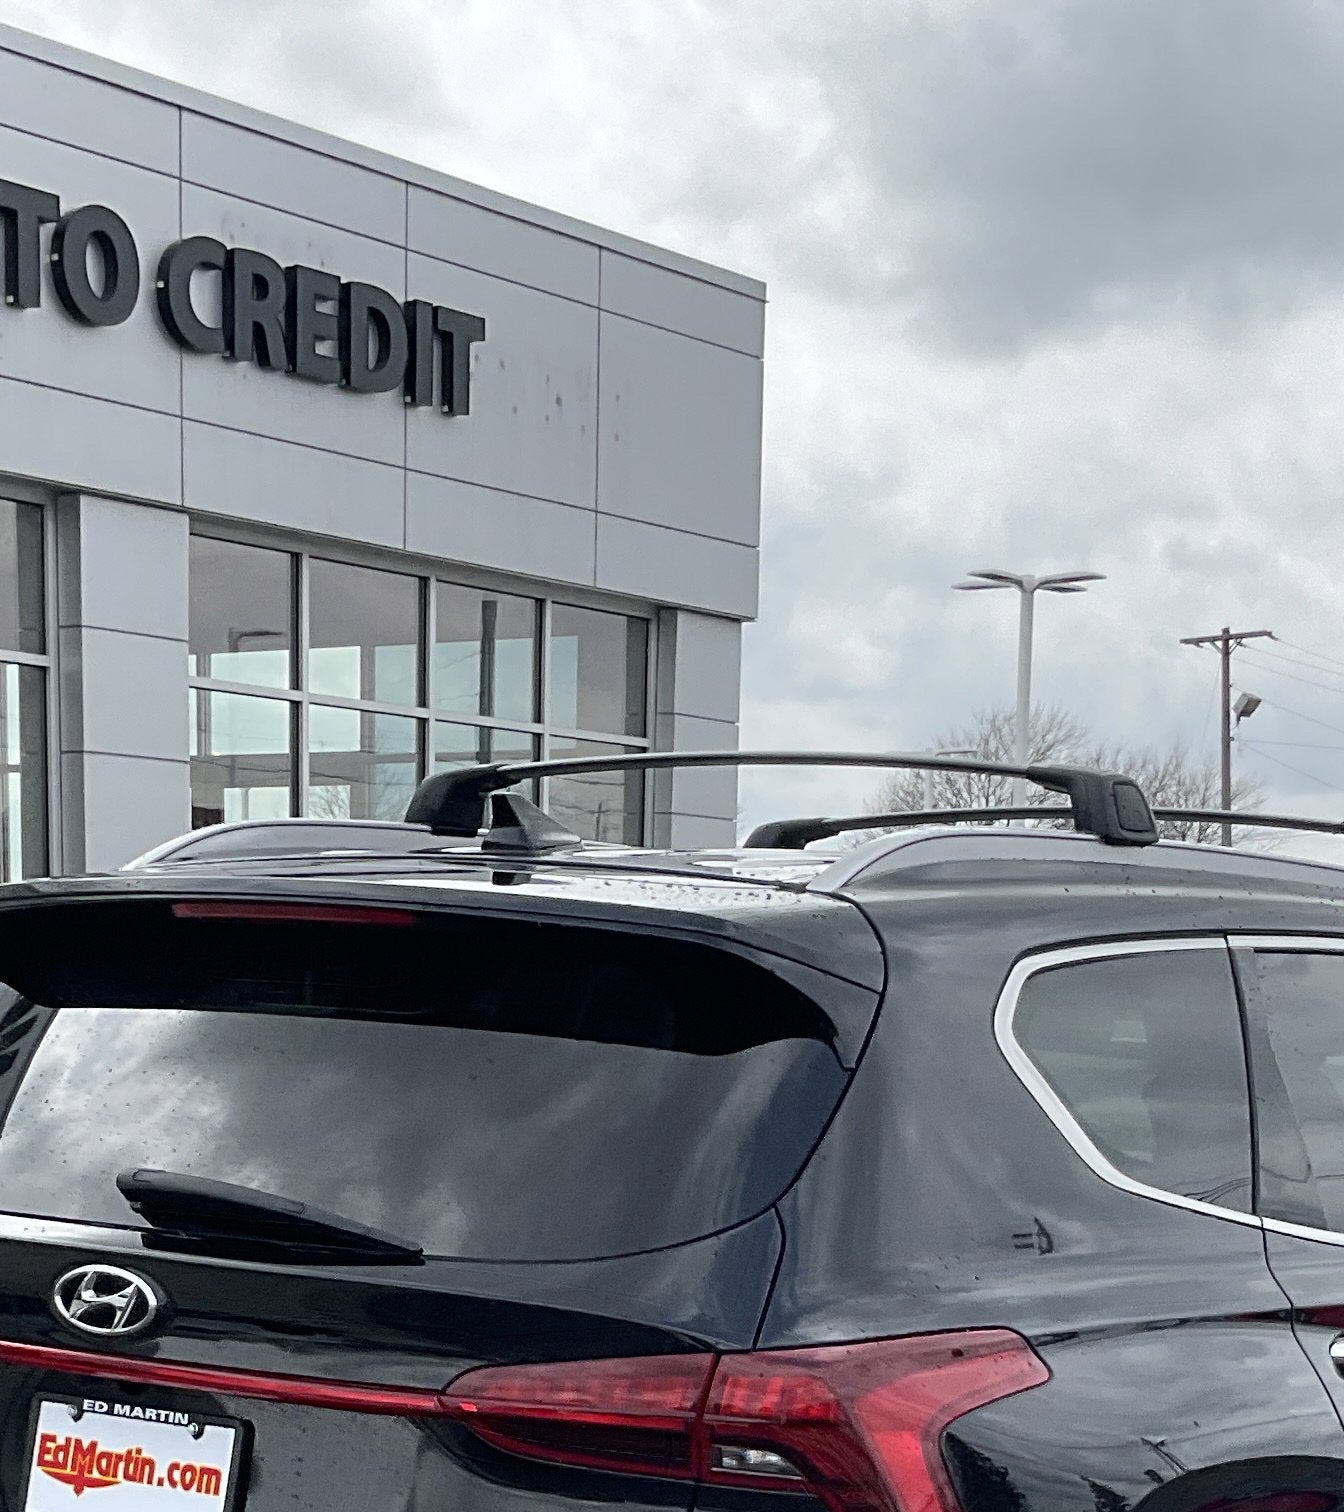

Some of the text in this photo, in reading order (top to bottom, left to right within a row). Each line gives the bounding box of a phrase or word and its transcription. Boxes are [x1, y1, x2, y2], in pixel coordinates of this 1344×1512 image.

[157, 236, 486, 417] CREDIT
[83, 1399, 189, 1425] ED MARTIN
[37, 1432, 222, 1497] EdMartin.com
